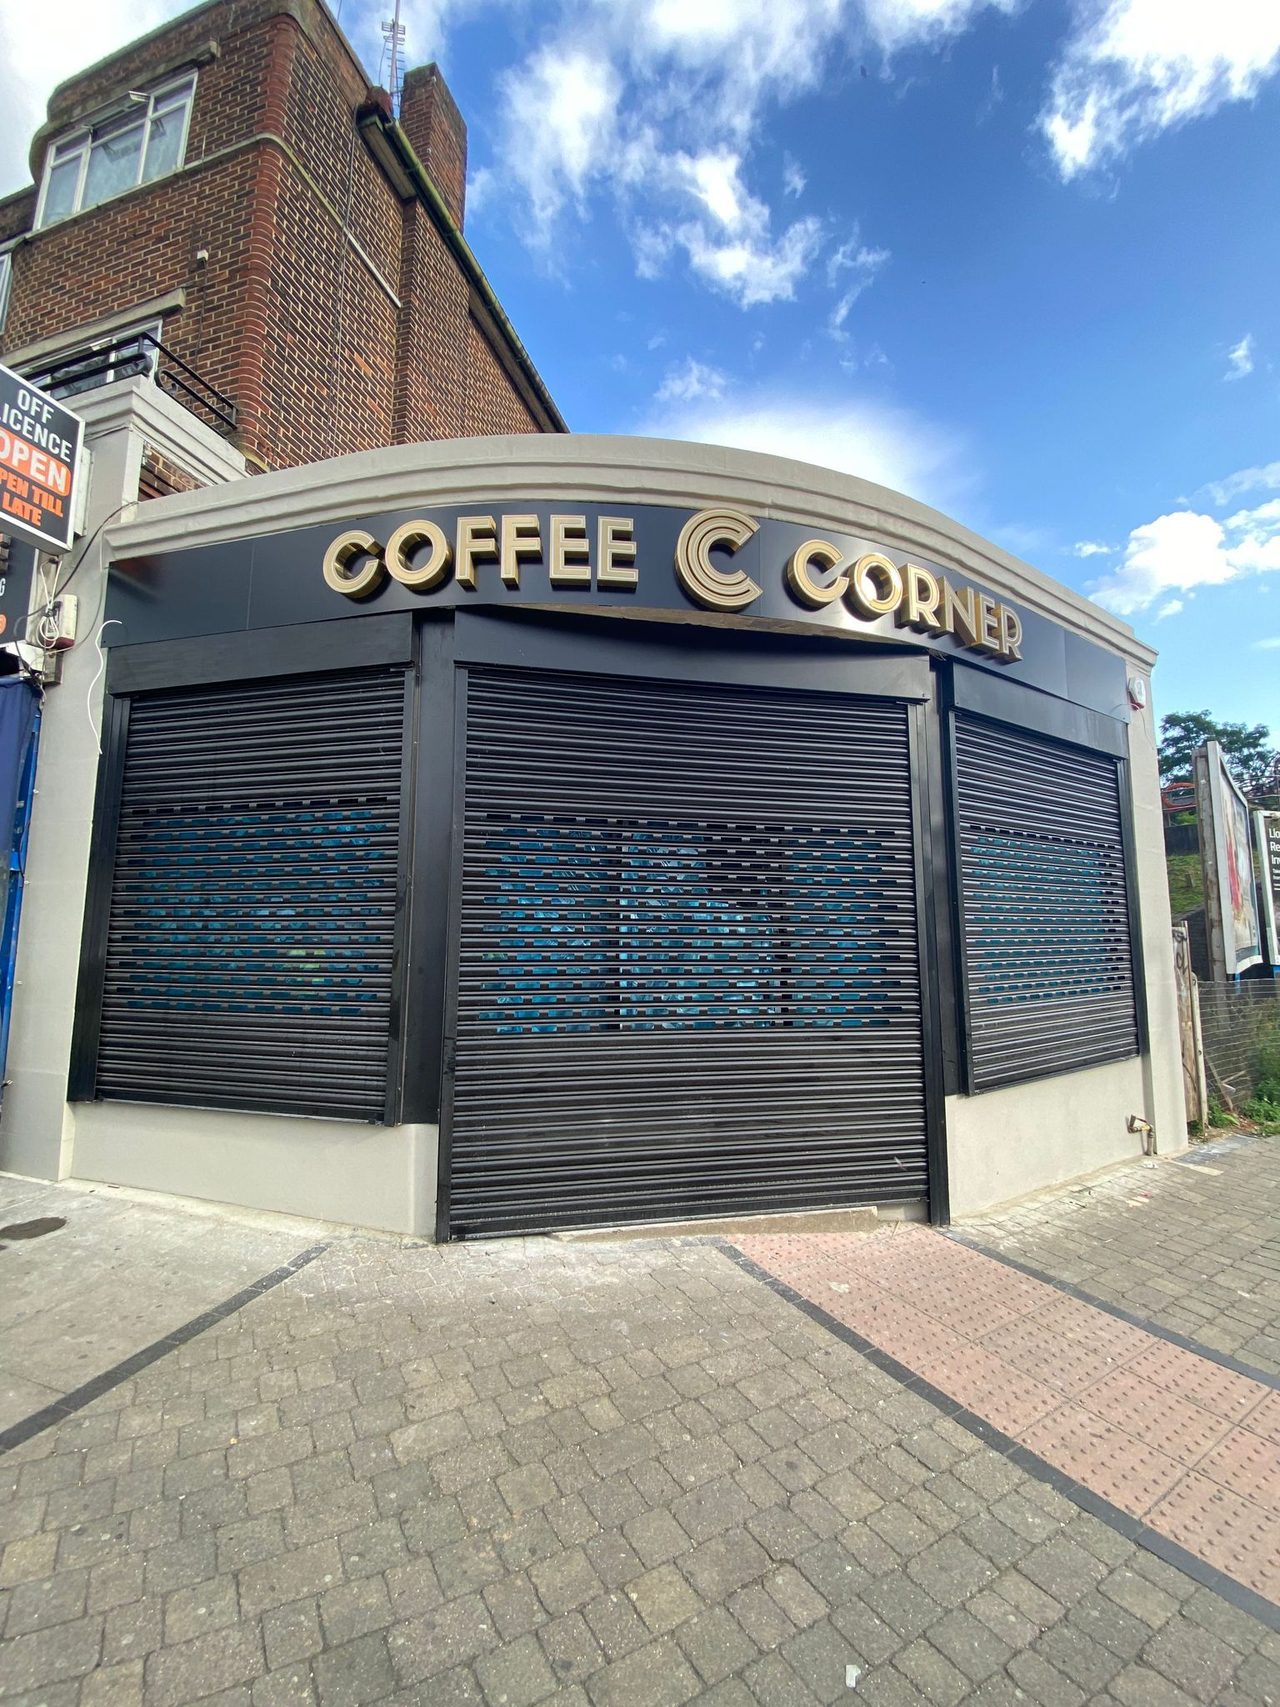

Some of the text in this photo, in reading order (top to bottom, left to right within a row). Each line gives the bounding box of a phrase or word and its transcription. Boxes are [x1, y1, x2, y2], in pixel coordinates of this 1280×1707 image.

[17, 388, 55, 425] OFF
[0, 403, 73, 463] ICENCE
[2, 491, 42, 527] LATE
[32, 485, 64, 518] TILL
[322, 506, 1024, 663] COFFEE C CORNER
